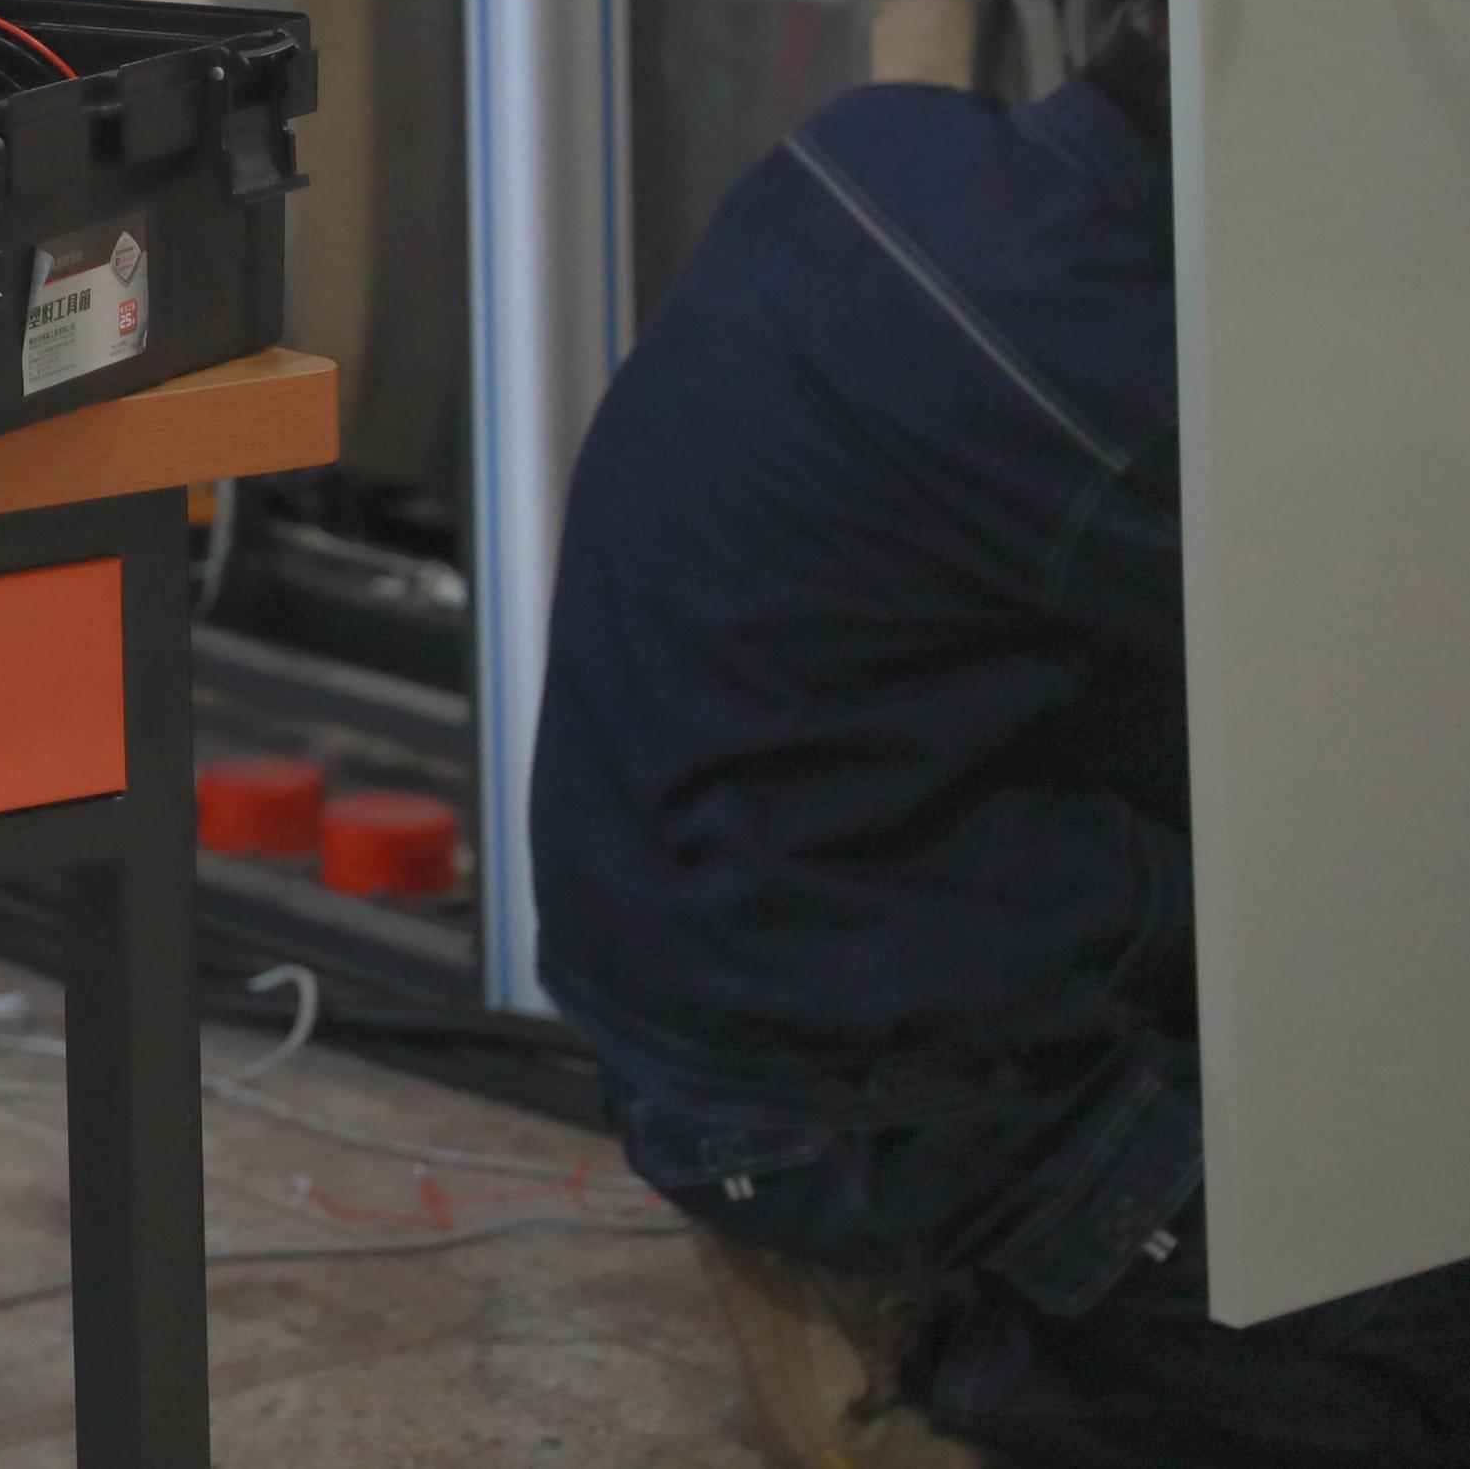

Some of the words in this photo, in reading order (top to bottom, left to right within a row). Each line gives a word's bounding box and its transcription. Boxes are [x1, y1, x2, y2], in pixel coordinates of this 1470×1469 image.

[29, 289, 91, 329] 塑料工具箱
